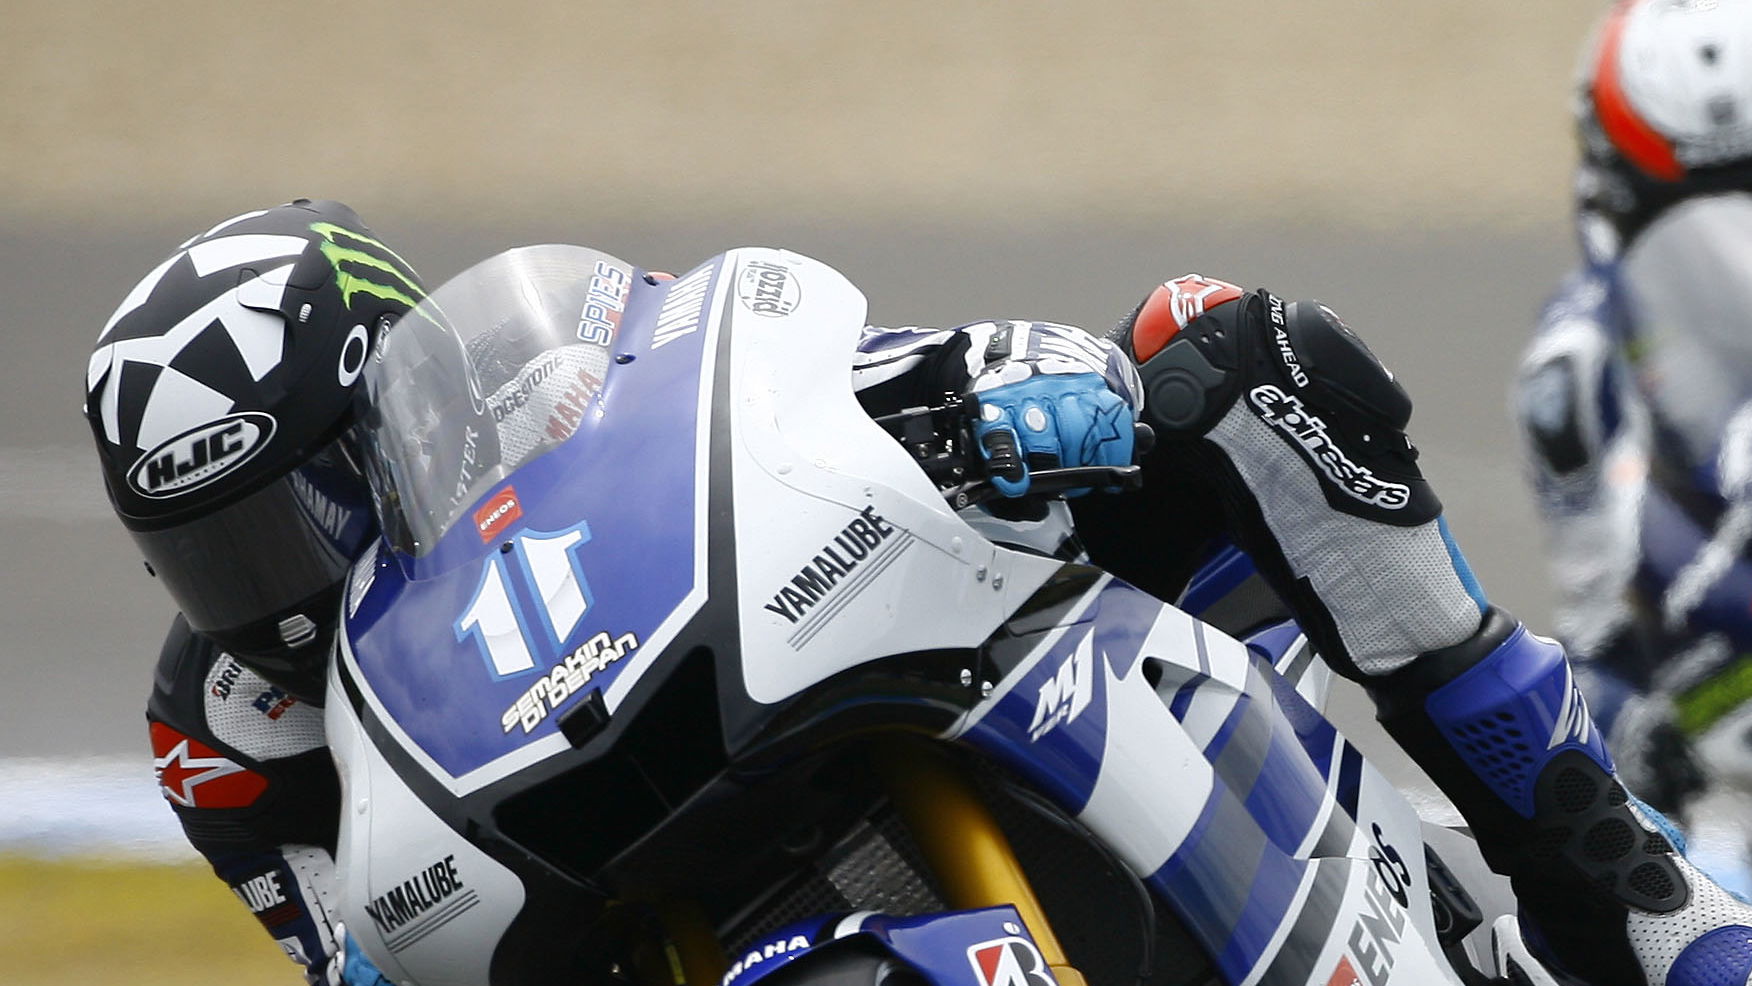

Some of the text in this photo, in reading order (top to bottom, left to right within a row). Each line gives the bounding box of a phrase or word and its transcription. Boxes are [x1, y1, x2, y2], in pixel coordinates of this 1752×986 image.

[577, 260, 632, 346] SPIES
[1274, 327, 1309, 387] AHEAD
[147, 422, 243, 490] HJC
[480, 500, 515, 531] ENEOS
[764, 505, 897, 624] YAMALUBE
[501, 631, 612, 734] SEMAKIN
[520, 632, 638, 734] DI DEPAN
[365, 855, 464, 934] YAMALUBE
